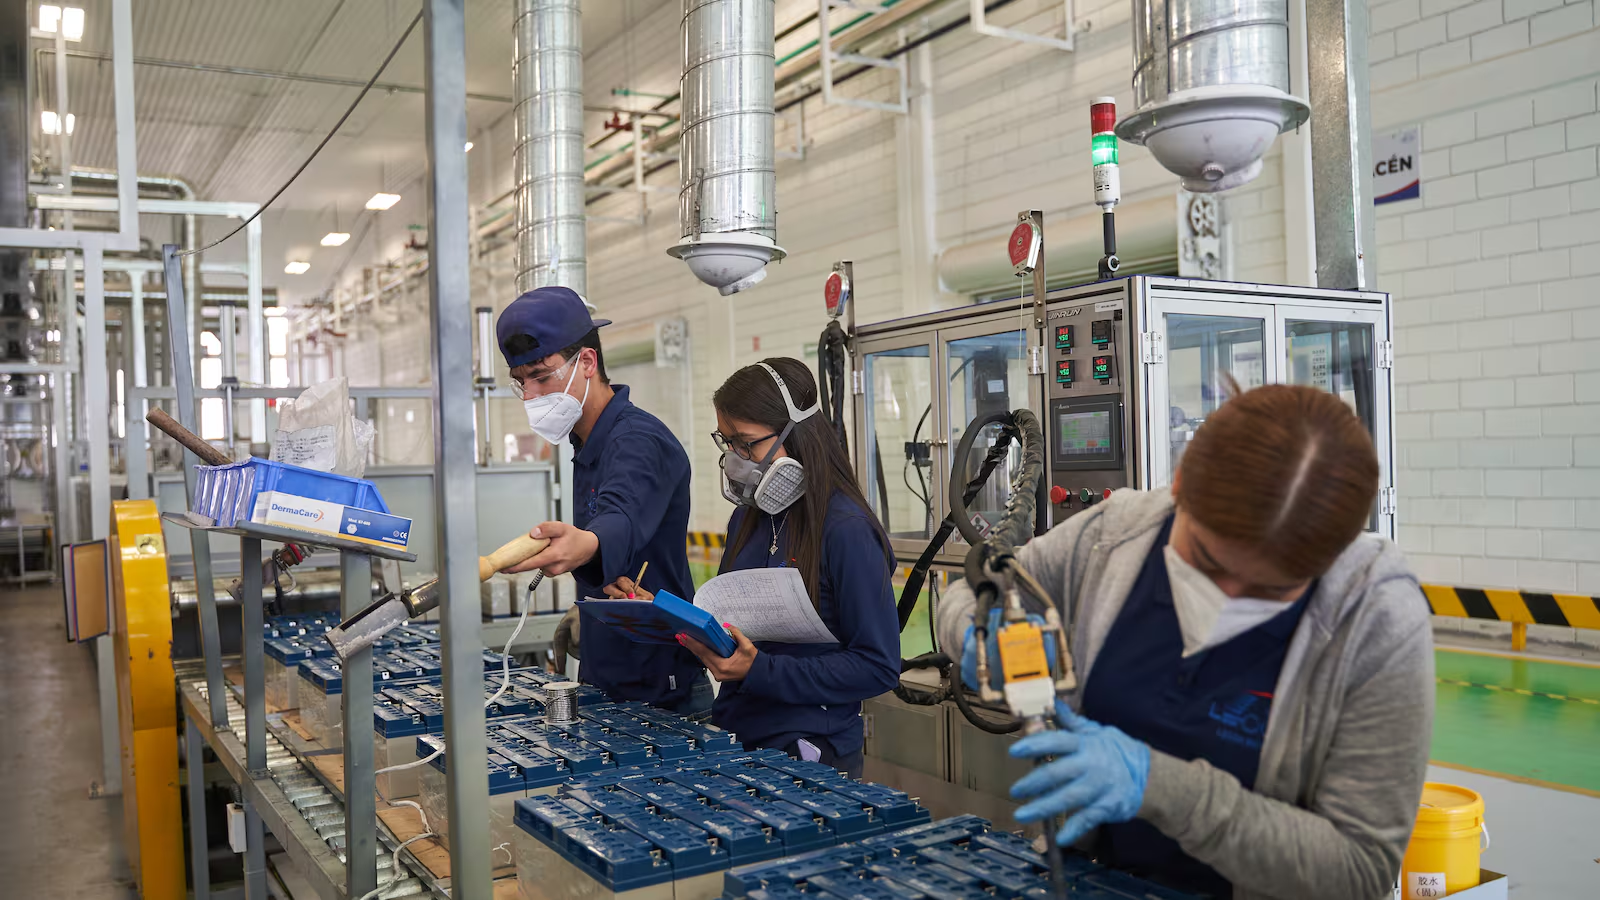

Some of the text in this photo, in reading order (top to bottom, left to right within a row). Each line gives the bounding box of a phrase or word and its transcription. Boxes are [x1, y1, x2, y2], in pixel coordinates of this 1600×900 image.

[1373, 153, 1412, 177] CÉN
[1048, 308, 1082, 320] JINRUN
[271, 503, 319, 519] DermaCare
